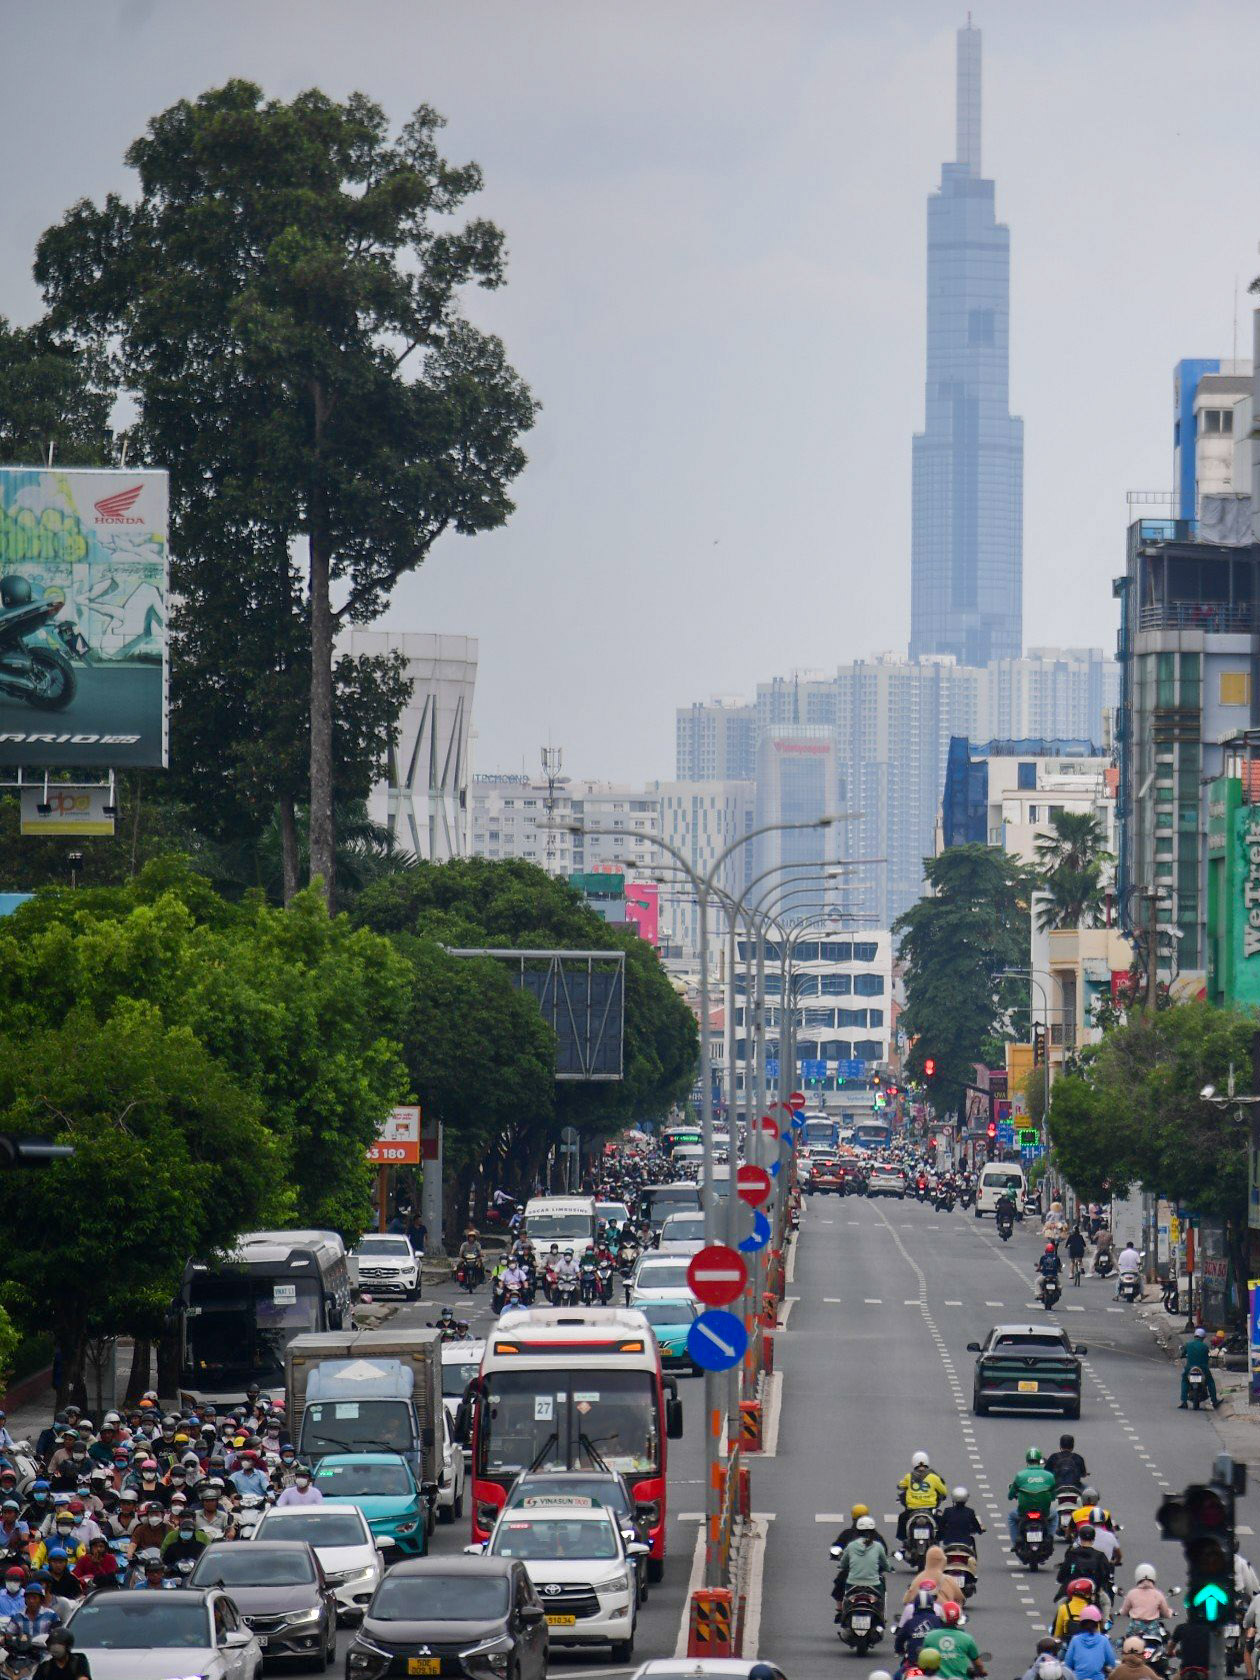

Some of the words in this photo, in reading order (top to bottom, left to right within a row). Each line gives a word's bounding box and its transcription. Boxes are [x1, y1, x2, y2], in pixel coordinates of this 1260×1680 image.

[94, 517, 145, 525] HONDA
[382, 1149, 406, 1159] 180
[537, 1402, 551, 1415] 27
[910, 1477, 931, 1492] be
[540, 1497, 573, 1505] VINASUN
[574, 1498, 590, 1507] TAXI
